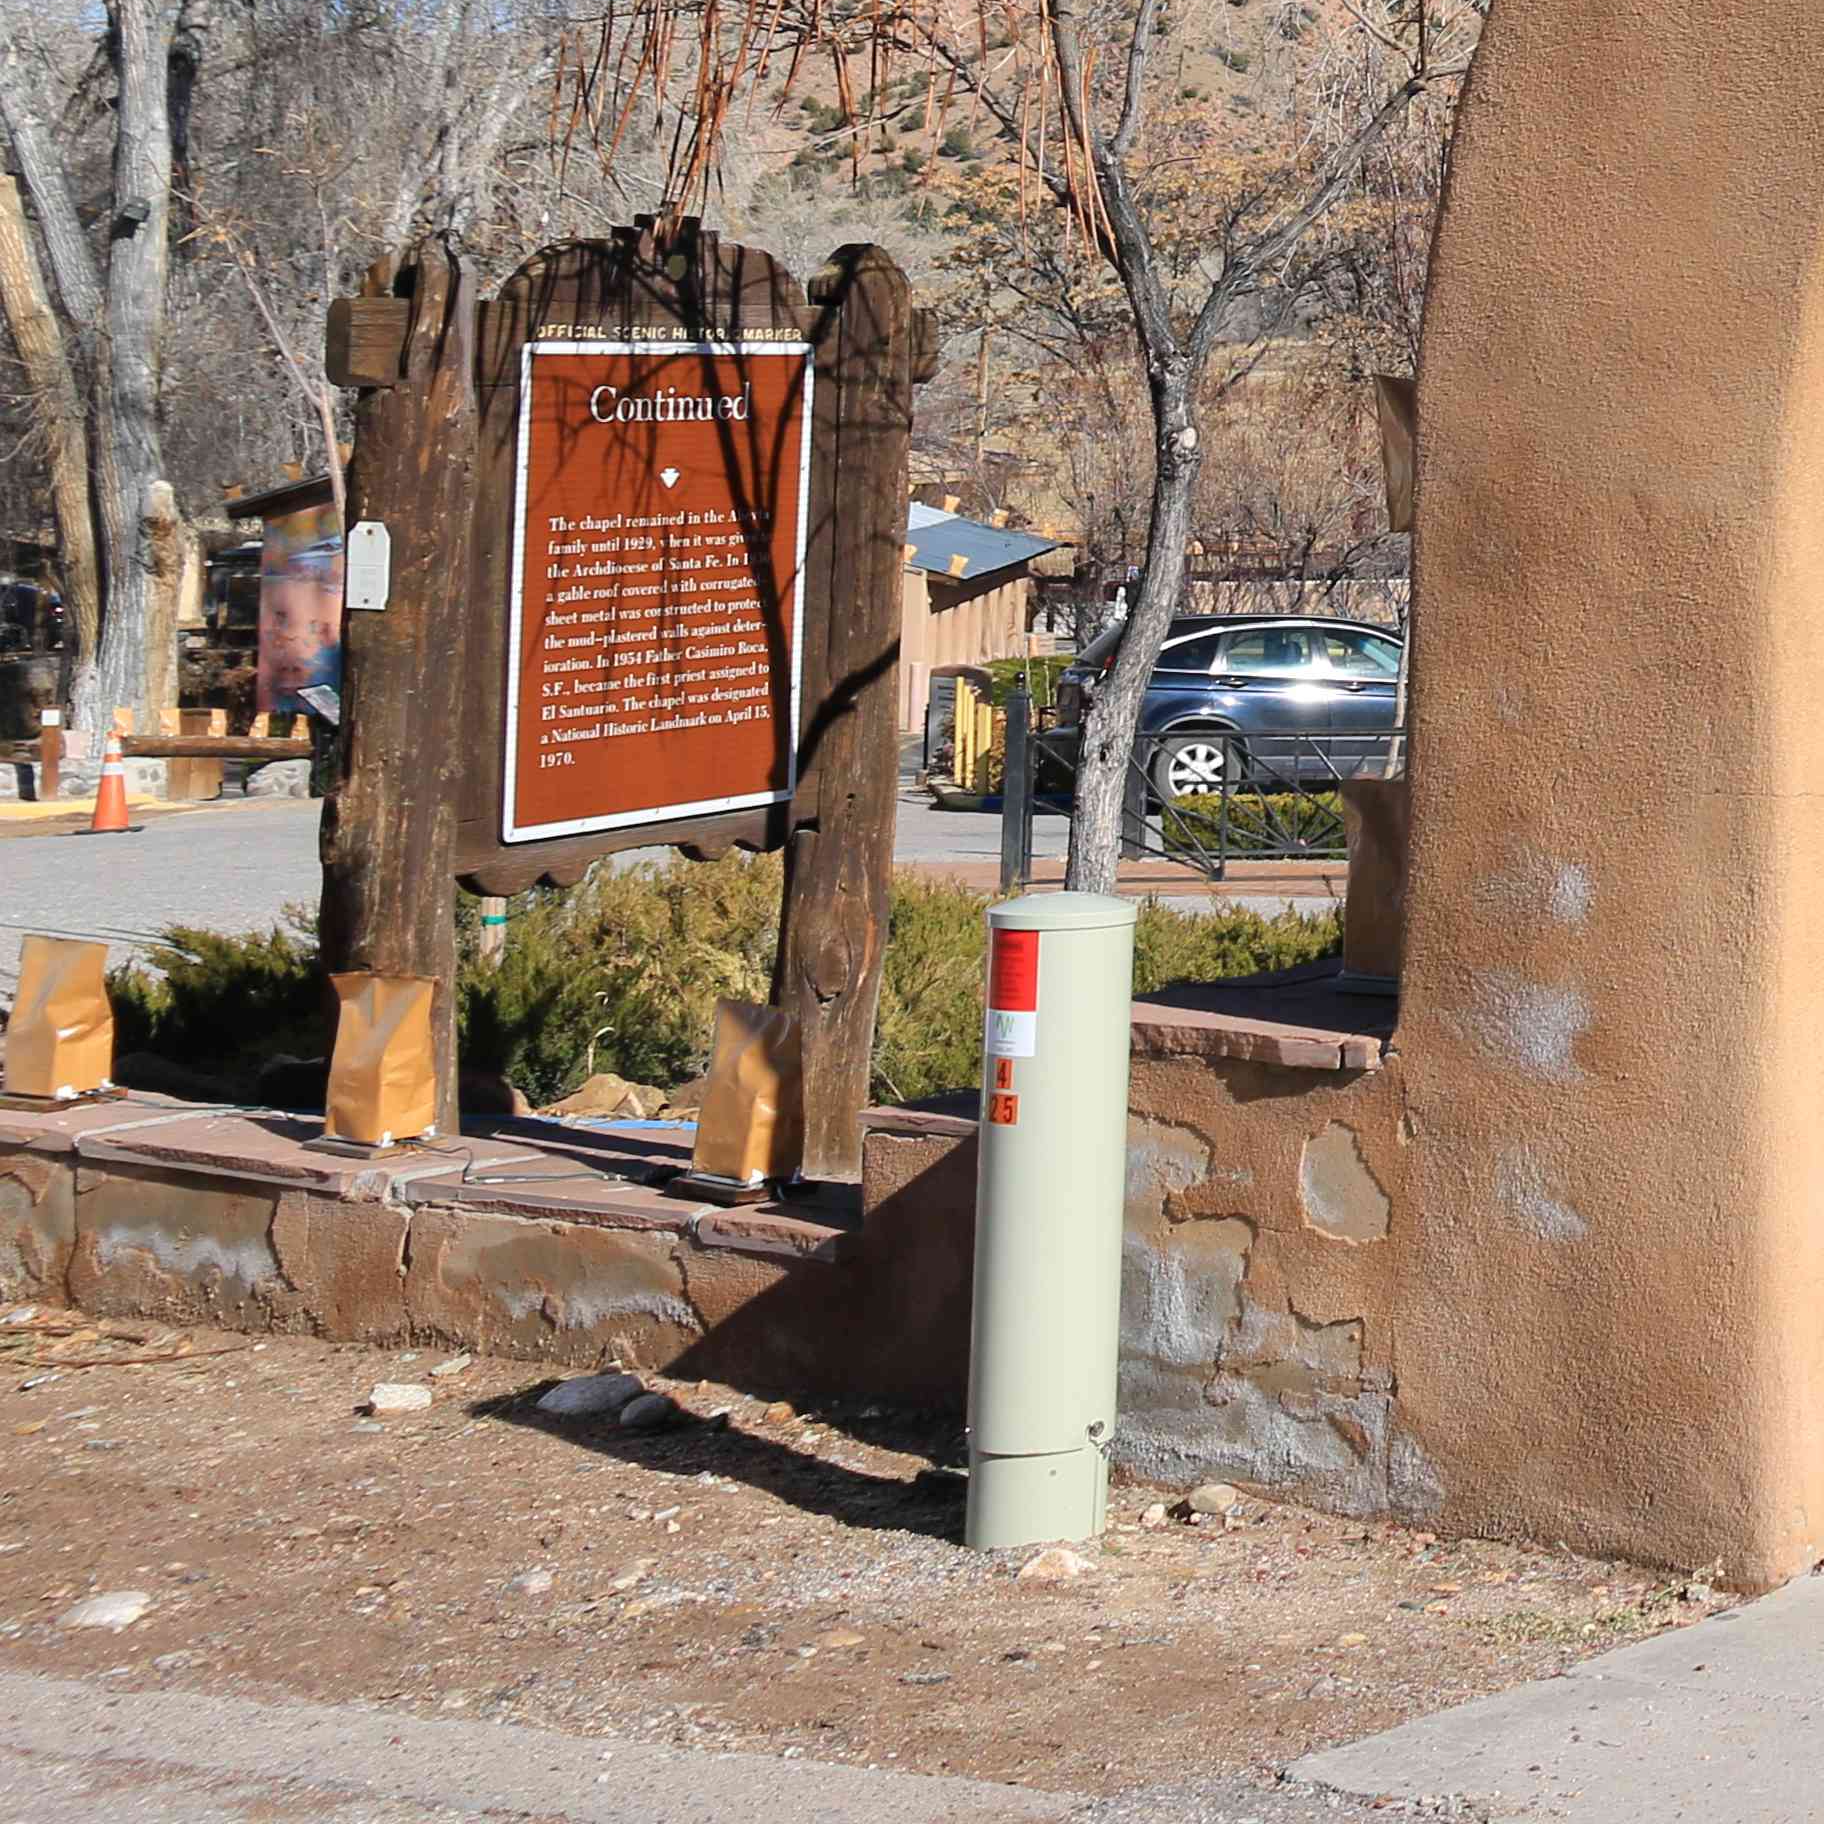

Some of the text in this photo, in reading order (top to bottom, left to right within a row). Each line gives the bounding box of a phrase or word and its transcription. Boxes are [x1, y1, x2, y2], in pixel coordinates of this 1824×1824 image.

[537, 325, 607, 339] OFFICIAL
[613, 326, 667, 340] SCENIC
[743, 328, 802, 341] MARKER
[590, 381, 751, 423] Continued
[549, 516, 576, 531] The
[580, 514, 621, 532] chapel
[625, 510, 684, 527] remained
[688, 512, 700, 524] in
[704, 509, 725, 523] the
[548, 538, 588, 556] family
[591, 536, 620, 552] until
[693, 534, 702, 546] it
[705, 535, 726, 545] was
[547, 563, 570, 578] the
[573, 560, 648, 577] Archdiocese
[651, 557, 664, 571] of
[669, 558, 702, 570] Santa
[705, 554, 723, 568] Fe.
[727, 553, 739, 567] In
[545, 593, 554, 602] a
[557, 585, 591, 603] gable
[593, 583, 620, 598] roof
[622, 579, 667, 596] covered
[671, 578, 697, 592] with
[545, 611, 577, 626] sheet
[581, 607, 615, 623] metal
[619, 609, 641, 619] was
[714, 600, 725, 611] to
[544, 634, 566, 649] the
[691, 622, 730, 637] against
[733, 618, 767, 632] deter-
[544, 658, 593, 673] ioration.
[596, 655, 609, 668] In
[614, 652, 641, 666] 1954
[645, 648, 682, 663] Father
[685, 644, 735, 659] Casimiro
[574, 679, 621, 693] became
[624, 674, 645, 688] the
[646, 672, 670, 686] first
[674, 670, 706, 686] priest
[709, 661, 756, 680] assigned
[758, 664, 769, 674] to
[542, 682, 769, 720] El Santuario. The chapel was designated
[540, 735, 549, 744] a
[552, 724, 600, 743] National
[604, 720, 648, 736] Historic
[650, 712, 706, 732] Landmark
[708, 714, 722, 724] on
[724, 706, 752, 724] April
[540, 751, 575, 768] 1970.
[997, 1062, 1007, 1088] 4
